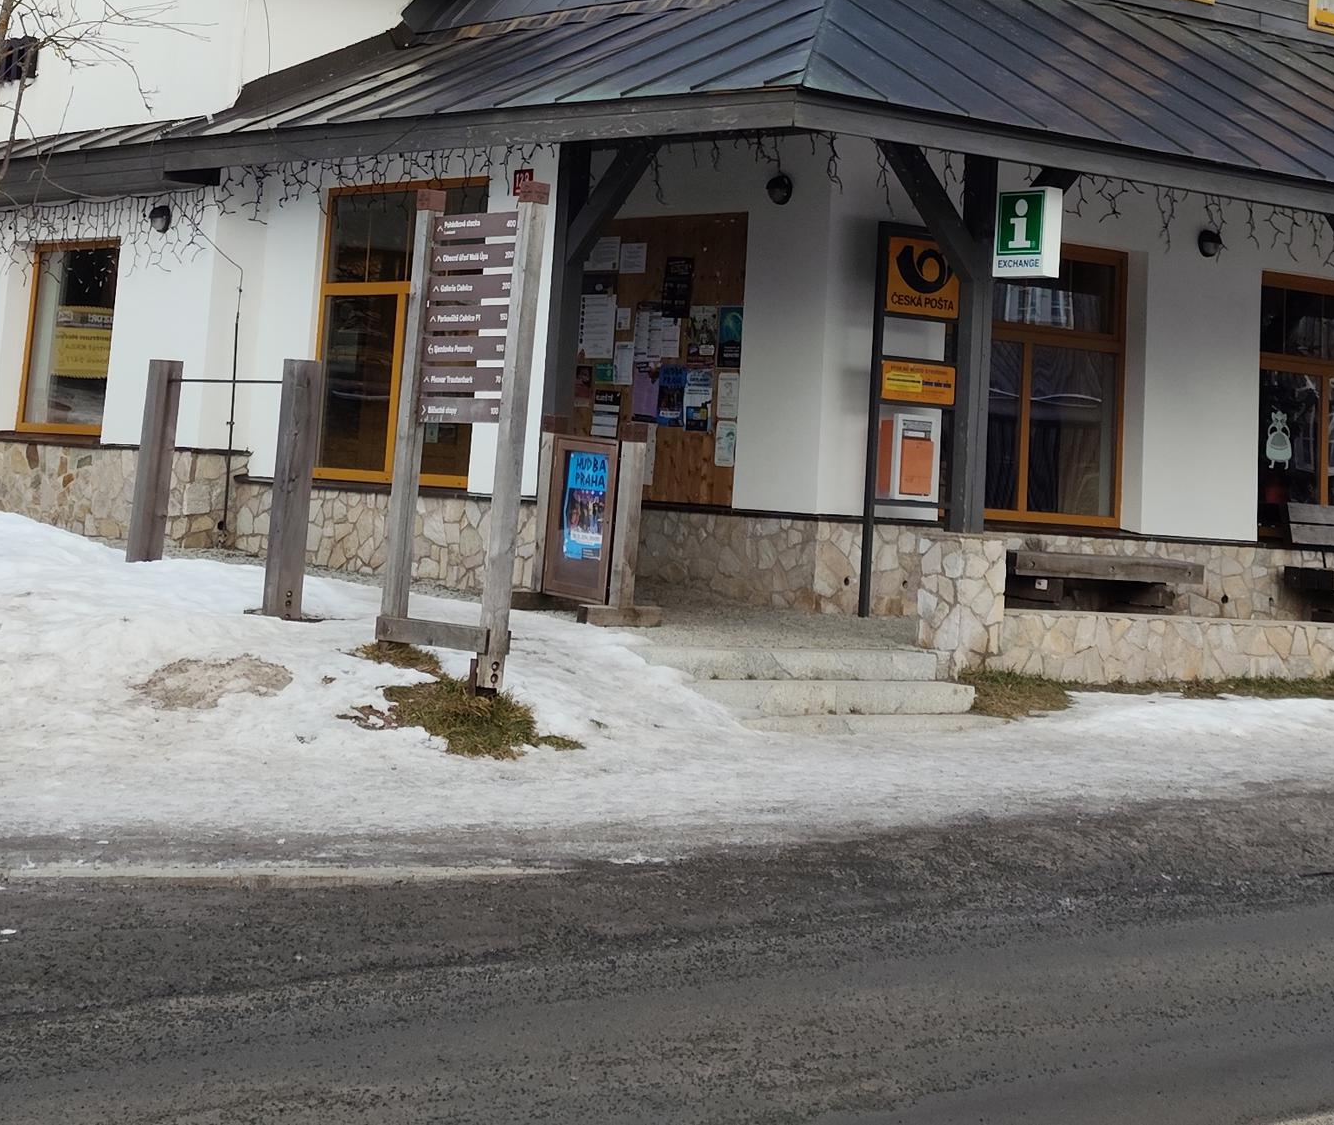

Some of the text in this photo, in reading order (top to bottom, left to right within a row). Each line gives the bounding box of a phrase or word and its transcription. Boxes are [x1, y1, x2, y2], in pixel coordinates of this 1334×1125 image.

[997, 259, 1040, 269] EXCHANGE
[890, 292, 954, 311] ČESKÁ POŠTA
[576, 456, 607, 474] HUDBA
[575, 472, 606, 488] PRAHA
